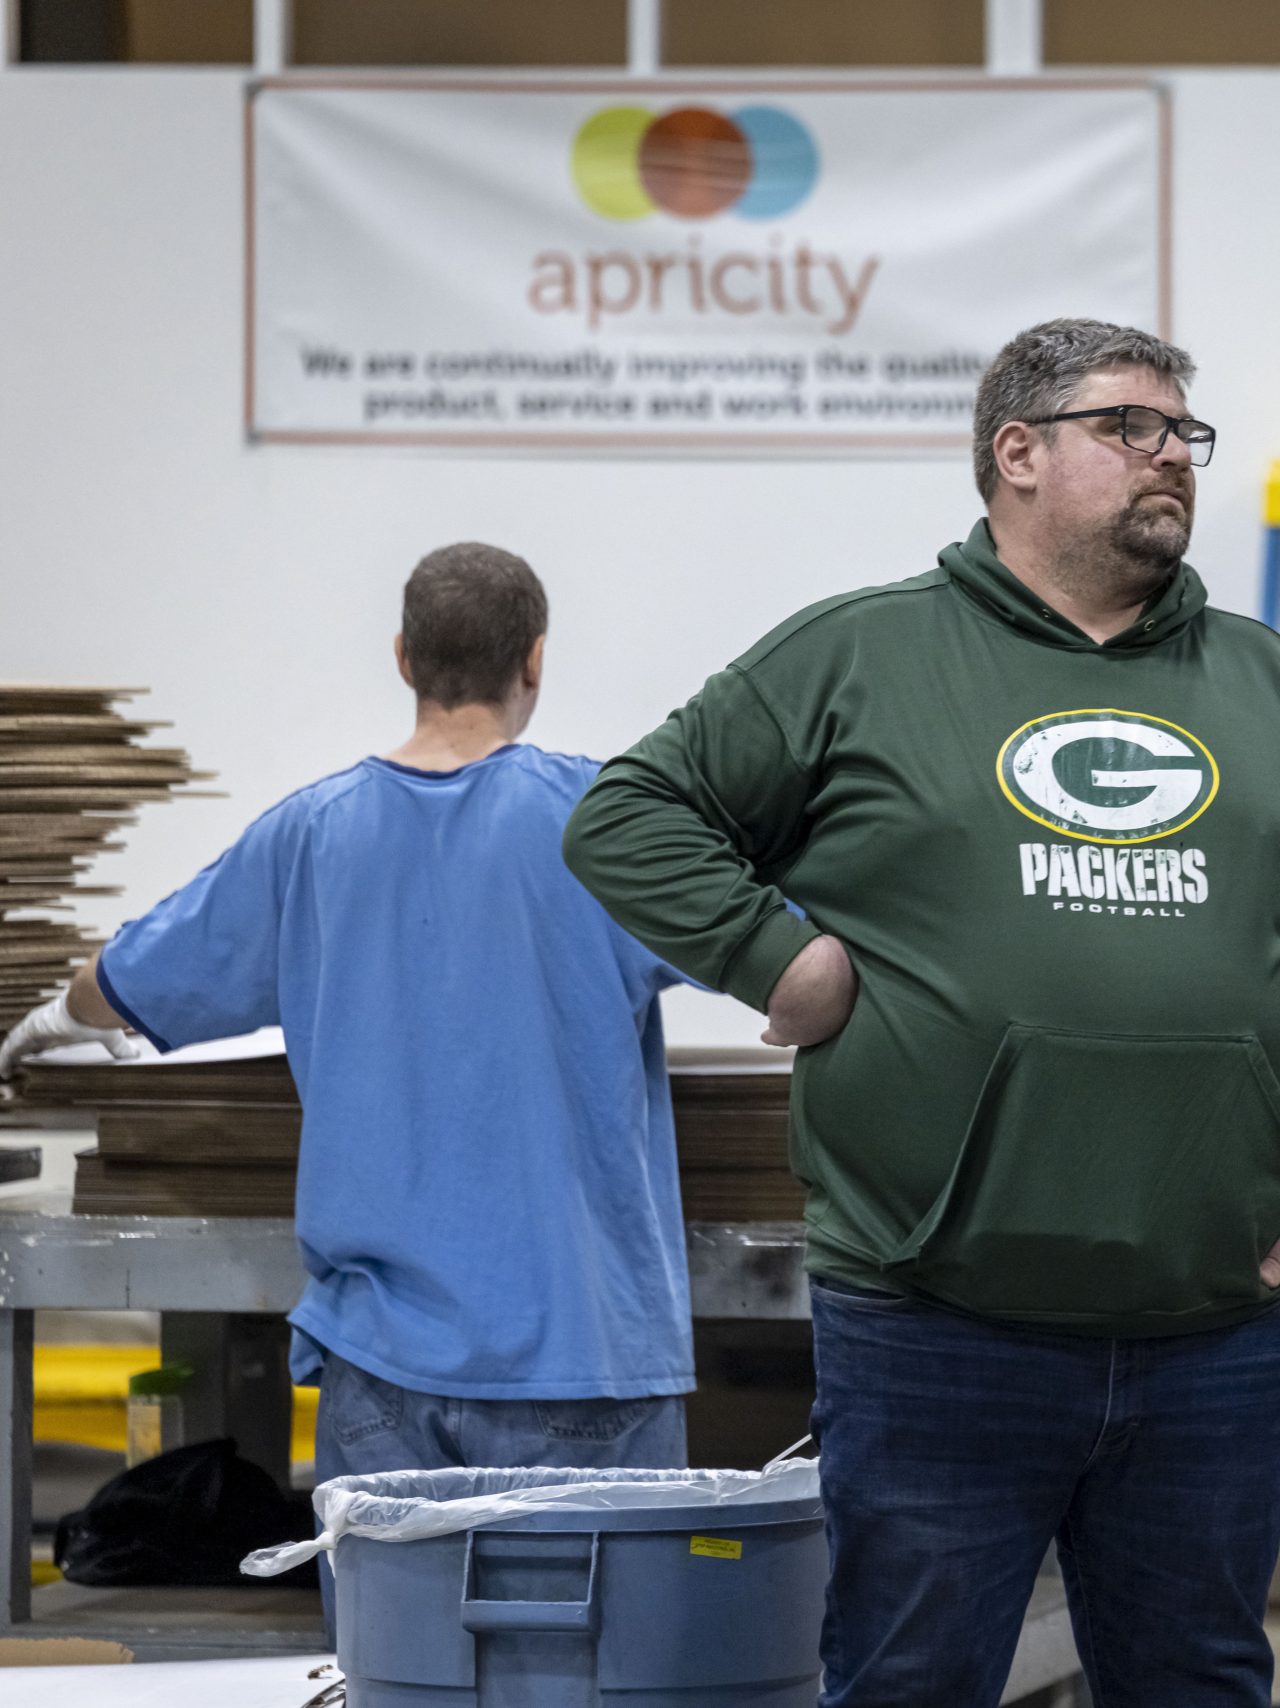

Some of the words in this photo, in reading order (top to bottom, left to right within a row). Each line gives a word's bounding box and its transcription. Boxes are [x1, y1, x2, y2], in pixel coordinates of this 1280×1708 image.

[527, 233, 880, 336] apricity
[301, 349, 352, 378] We
[361, 353, 414, 379] are
[422, 347, 616, 387] continually
[630, 351, 805, 387] improving
[814, 350, 869, 378] the
[515, 392, 635, 419] service
[646, 389, 712, 418] and
[718, 391, 807, 419] work
[1013, 720, 1202, 831] G
[1019, 843, 1209, 904] PACKERS
[1053, 902, 1186, 917] FOOTBALL
